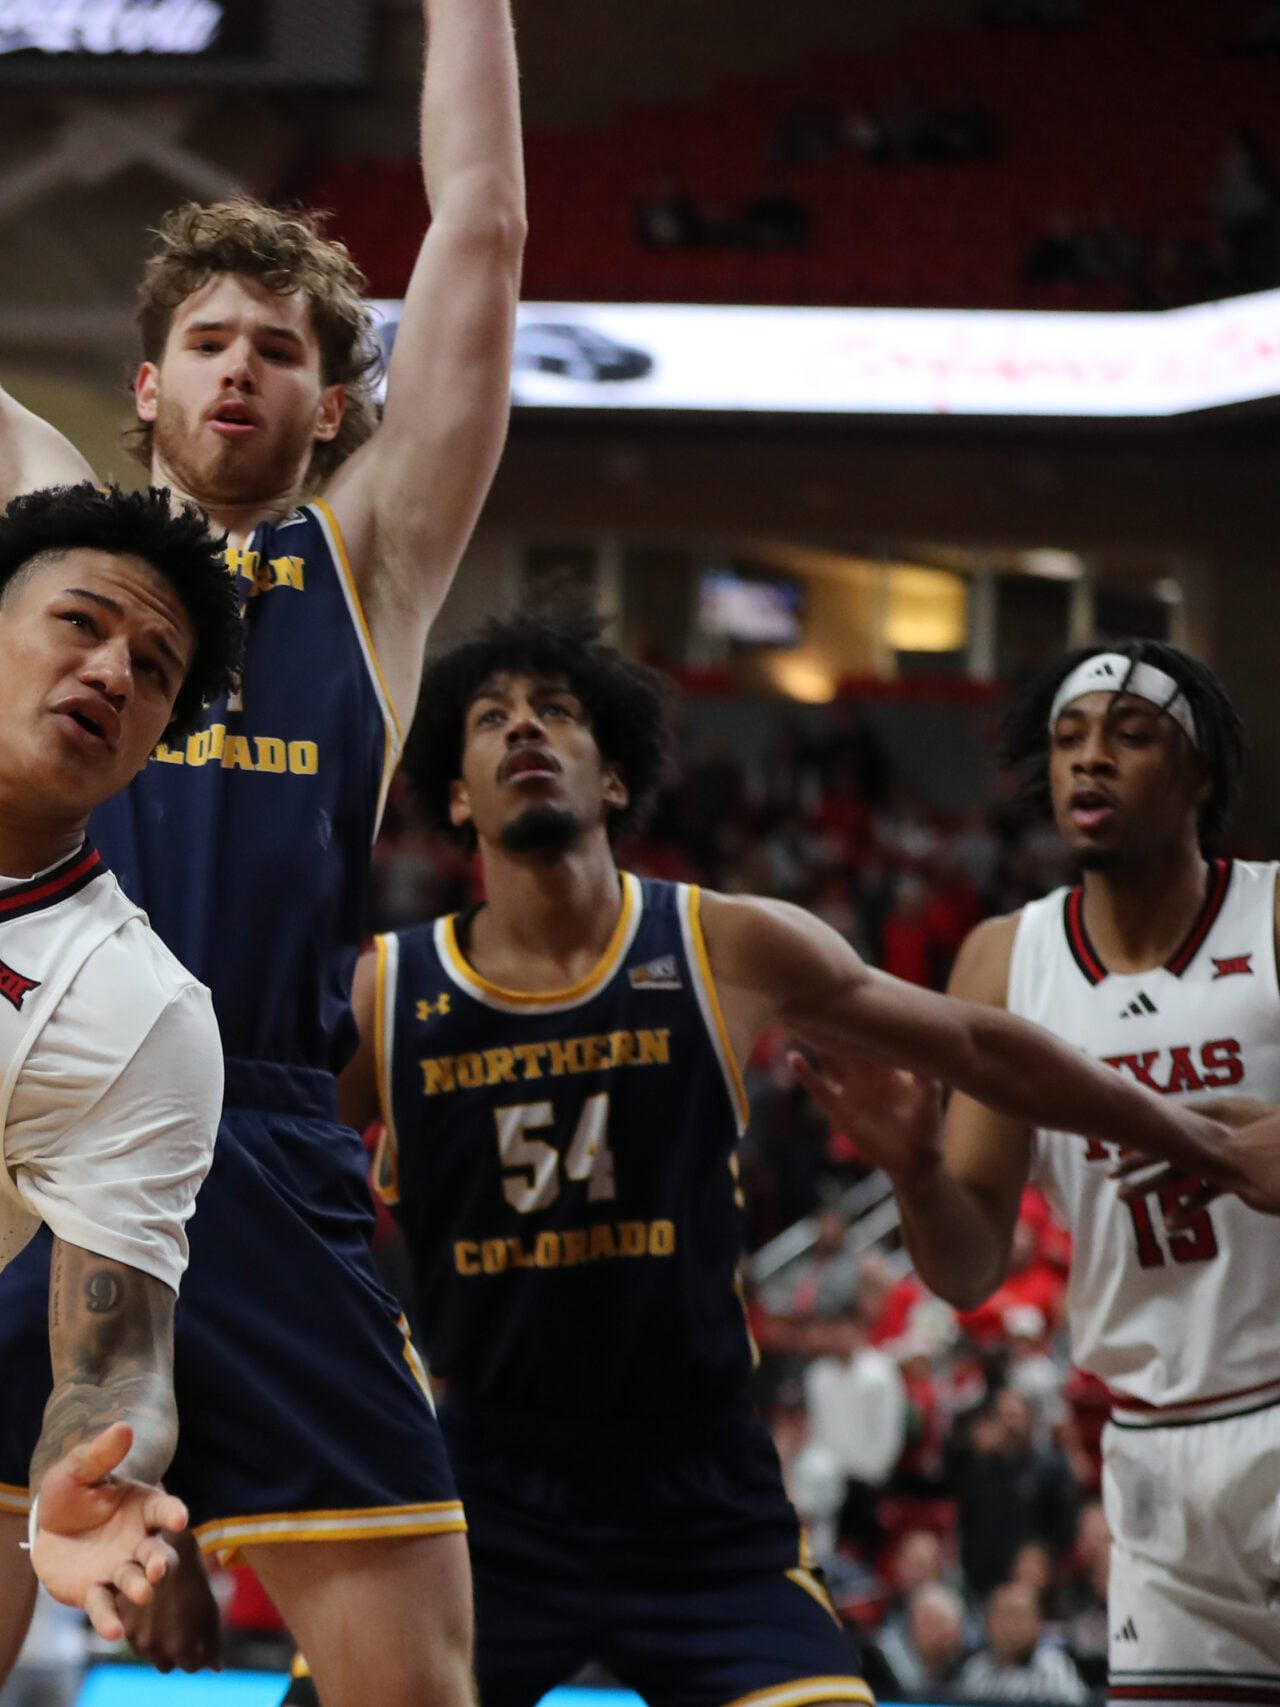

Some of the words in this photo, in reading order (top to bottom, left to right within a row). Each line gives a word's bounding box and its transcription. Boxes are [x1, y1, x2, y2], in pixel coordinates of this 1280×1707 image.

[420, 1028, 670, 1096] NORTHERN
[494, 1092, 617, 1214] 54
[453, 1220, 675, 1275] COLORADO
[1128, 1177, 1218, 1270] 15
